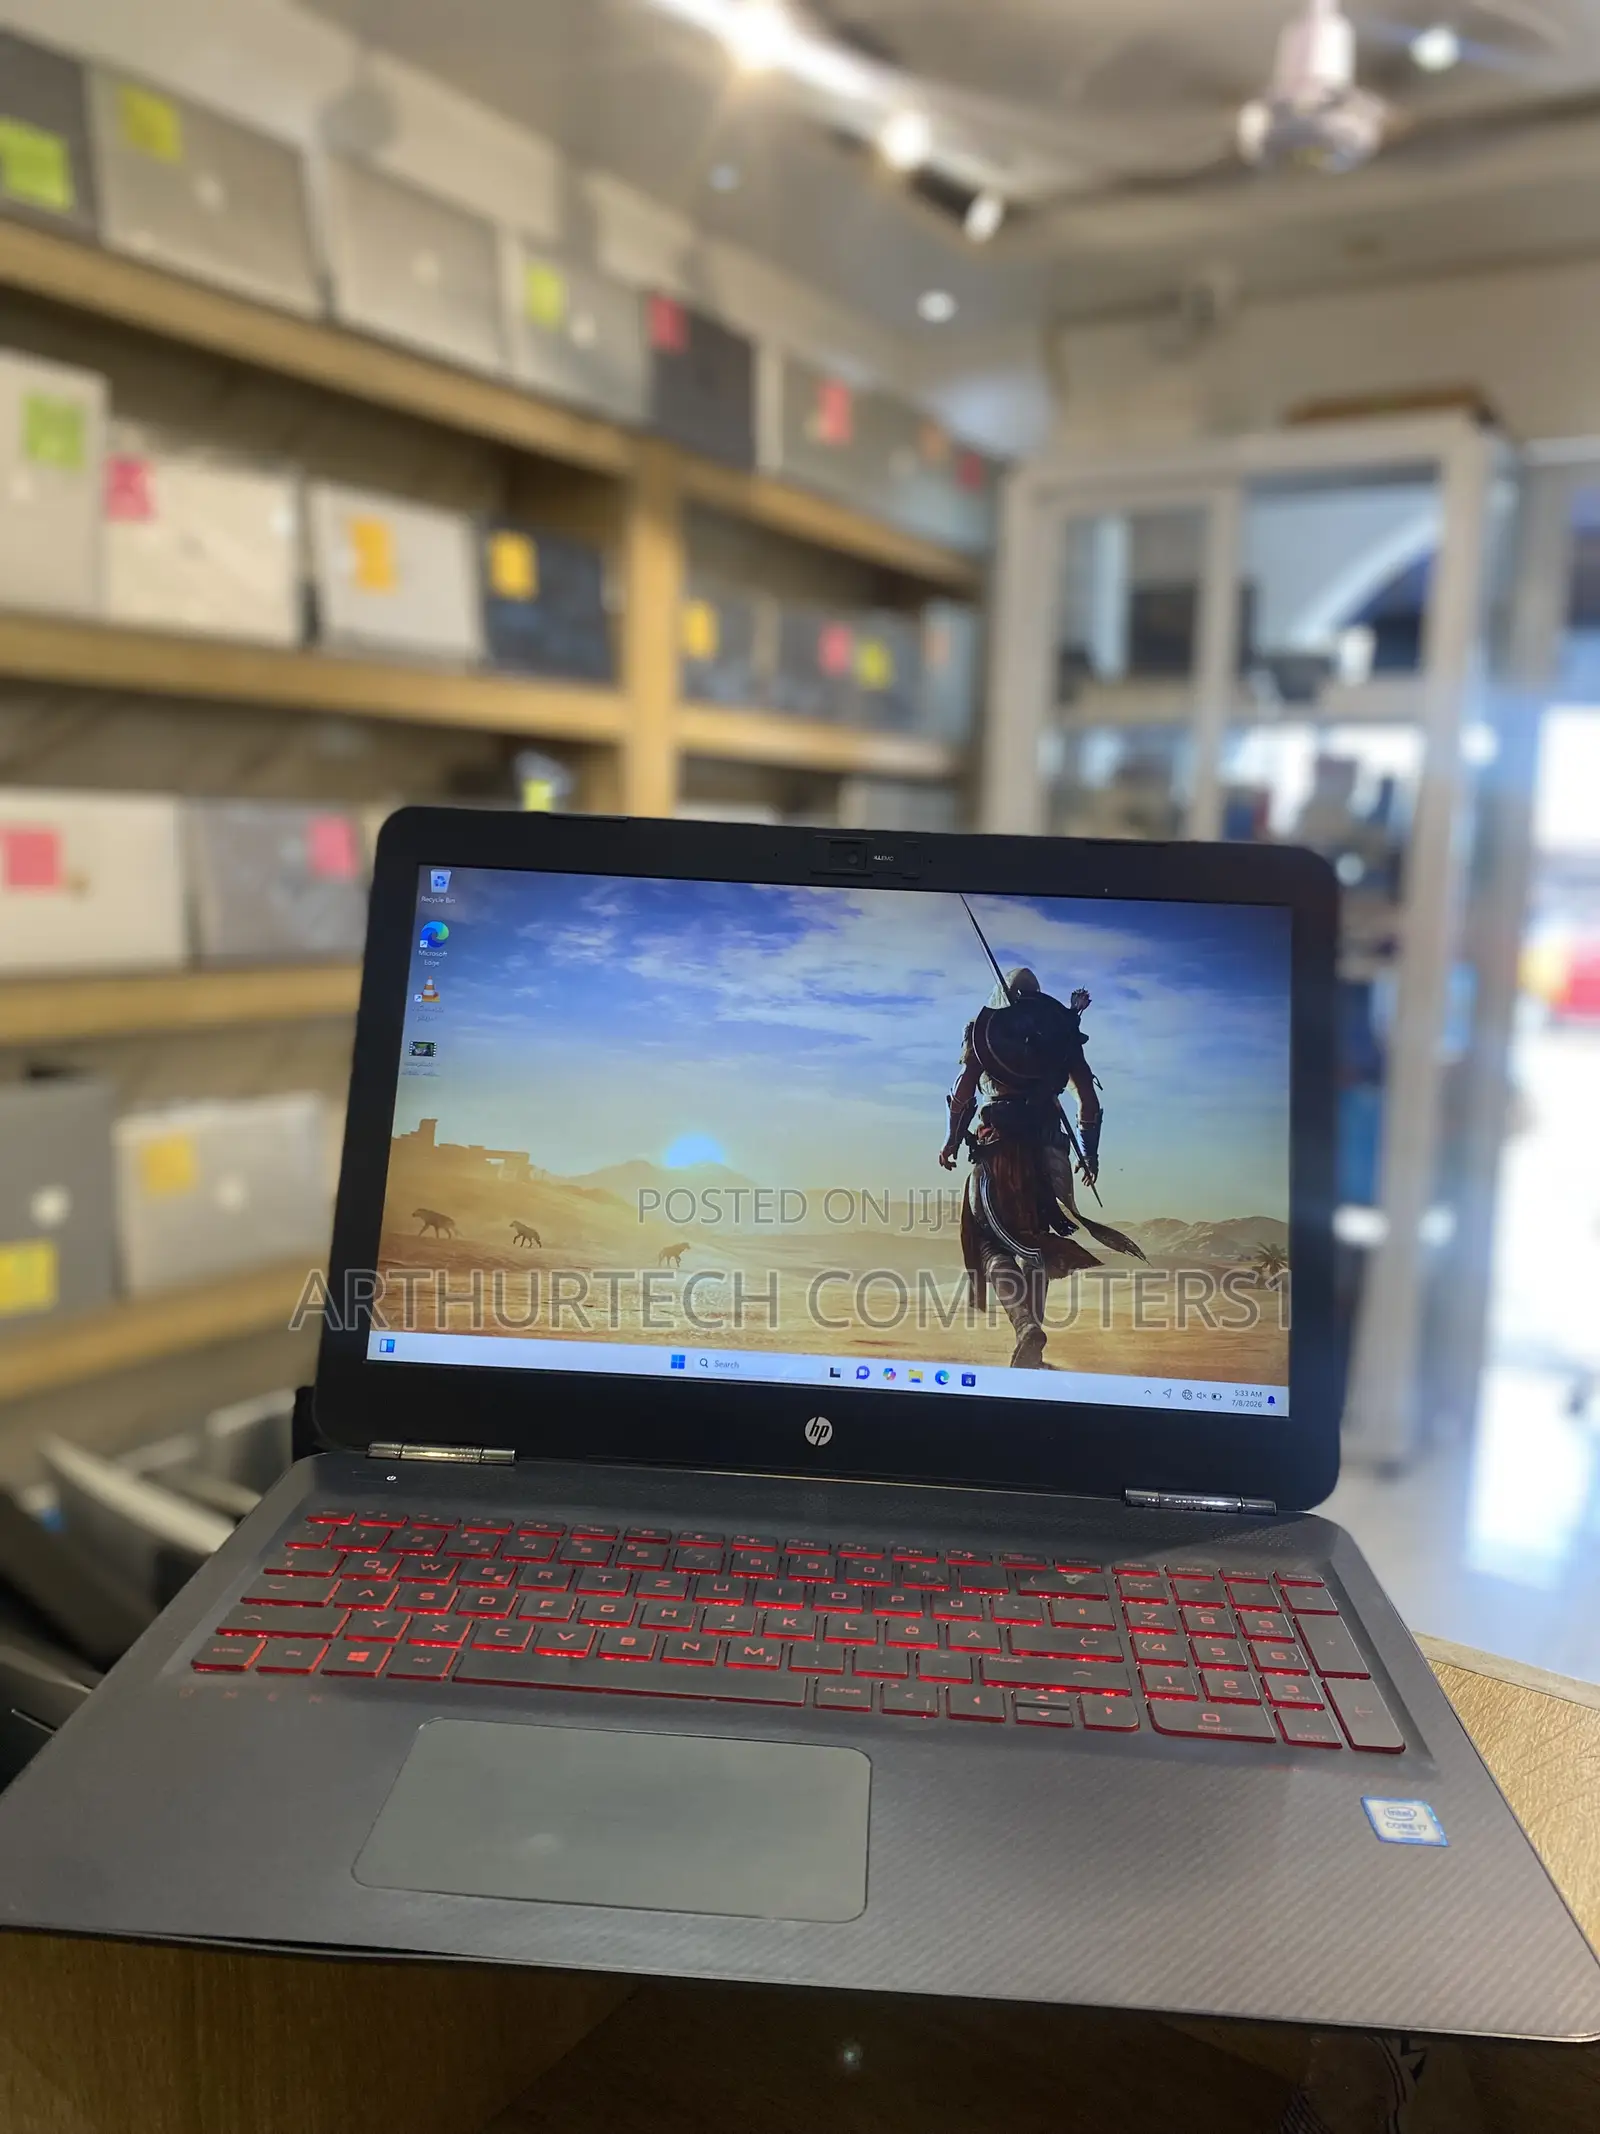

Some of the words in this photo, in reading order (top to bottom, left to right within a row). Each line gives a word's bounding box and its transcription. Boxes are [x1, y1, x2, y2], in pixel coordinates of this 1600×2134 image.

[421, 896, 444, 904] Recycle
[418, 950, 447, 958] Microsoft
[714, 1359, 740, 1370] Search
[1234, 1389, 1249, 1397] 5:33
[1250, 1390, 1263, 1398] AM
[1231, 1400, 1263, 1408] 7/8/2026
[806, 1416, 832, 1446] hp
[364, 1560, 381, 1569] Q
[420, 1563, 442, 1571] W
[481, 1567, 497, 1576] E
[538, 1571, 554, 1580] R
[597, 1575, 613, 1583] T
[655, 1579, 672, 1588] Z
[713, 1582, 730, 1592] U
[831, 1591, 848, 1600] O
[891, 1595, 905, 1603] P
[418, 1592, 436, 1600] S
[478, 1596, 497, 1605] D
[540, 1600, 556, 1608] F
[661, 1608, 678, 1618] H
[725, 1613, 736, 1623] J
[783, 1617, 797, 1627] K
[845, 1622, 858, 1631] L
[1142, 1611, 1157, 1620] 7
[372, 1619, 389, 1628] Y
[432, 1623, 450, 1633] X
[495, 1628, 513, 1637] C
[557, 1632, 577, 1641] V
[682, 1641, 700, 1651] N
[744, 1646, 765, 1656] M
[1151, 1643, 1168, 1652] 4
[1211, 1647, 1226, 1656] 5
[1270, 1651, 1287, 1660] 6
[1223, 1680, 1239, 1689] 2
[1284, 1684, 1300, 1694] 3
[1201, 1713, 1221, 1723] 0
